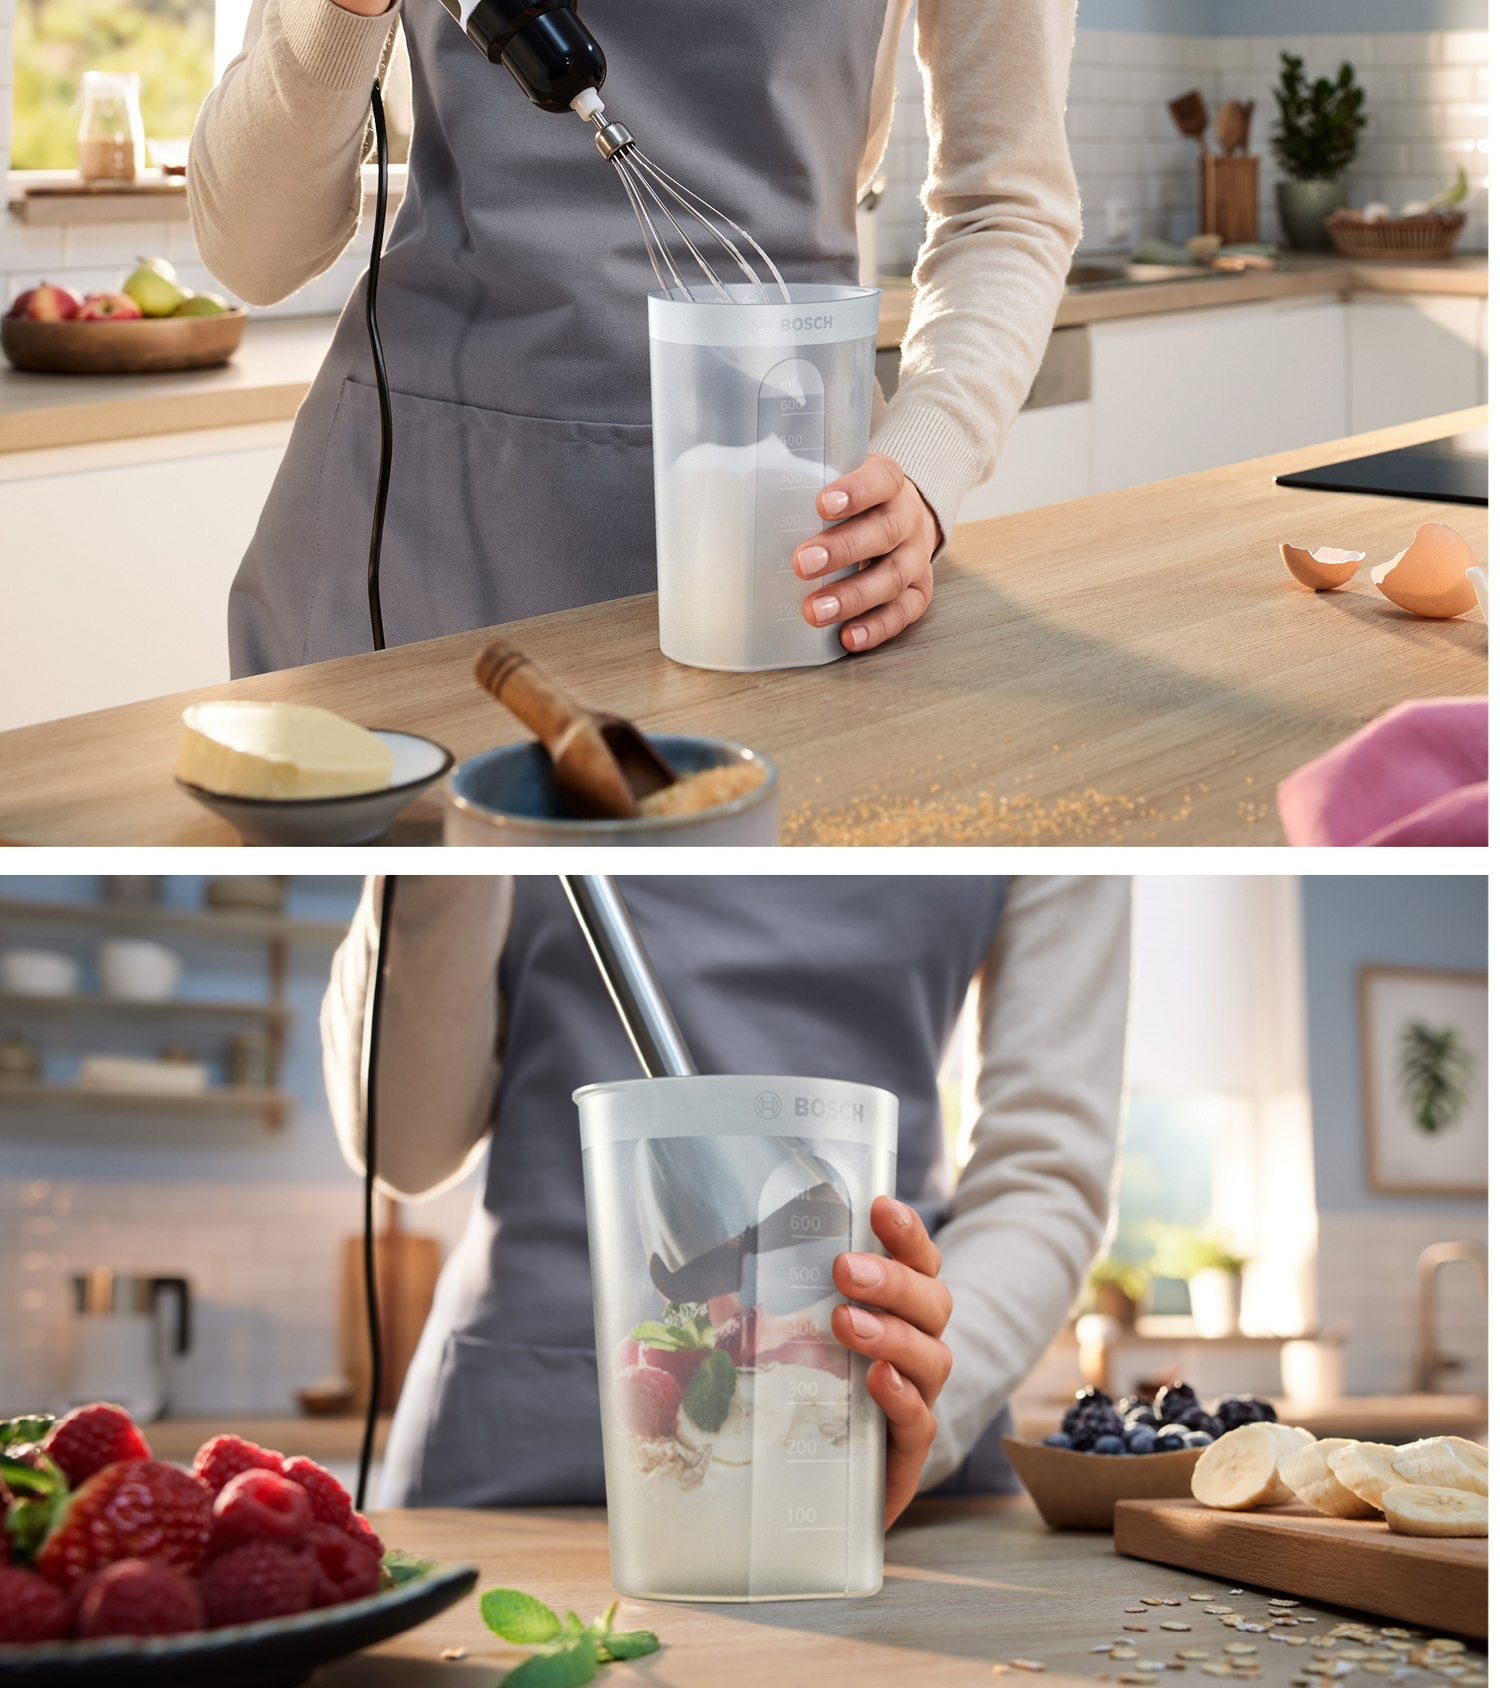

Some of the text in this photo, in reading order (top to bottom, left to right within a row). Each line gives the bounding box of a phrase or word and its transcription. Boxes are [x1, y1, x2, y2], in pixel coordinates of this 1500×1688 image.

[780, 316, 833, 331] BOSCH
[780, 378, 797, 389] ml
[780, 399, 803, 411] 600
[780, 435, 803, 446] 500
[779, 473, 802, 485] 400
[778, 515, 801, 527] 300
[778, 556, 793, 568] 20
[777, 603, 800, 615] 100
[794, 1096, 864, 1124] BOSCH
[790, 1184, 812, 1201] ml
[789, 1215, 821, 1231] 600
[789, 1266, 820, 1281] 500
[787, 1320, 819, 1336] 400
[786, 1381, 818, 1397] 300
[786, 1439, 817, 1455] 200
[785, 1507, 816, 1523] 100
